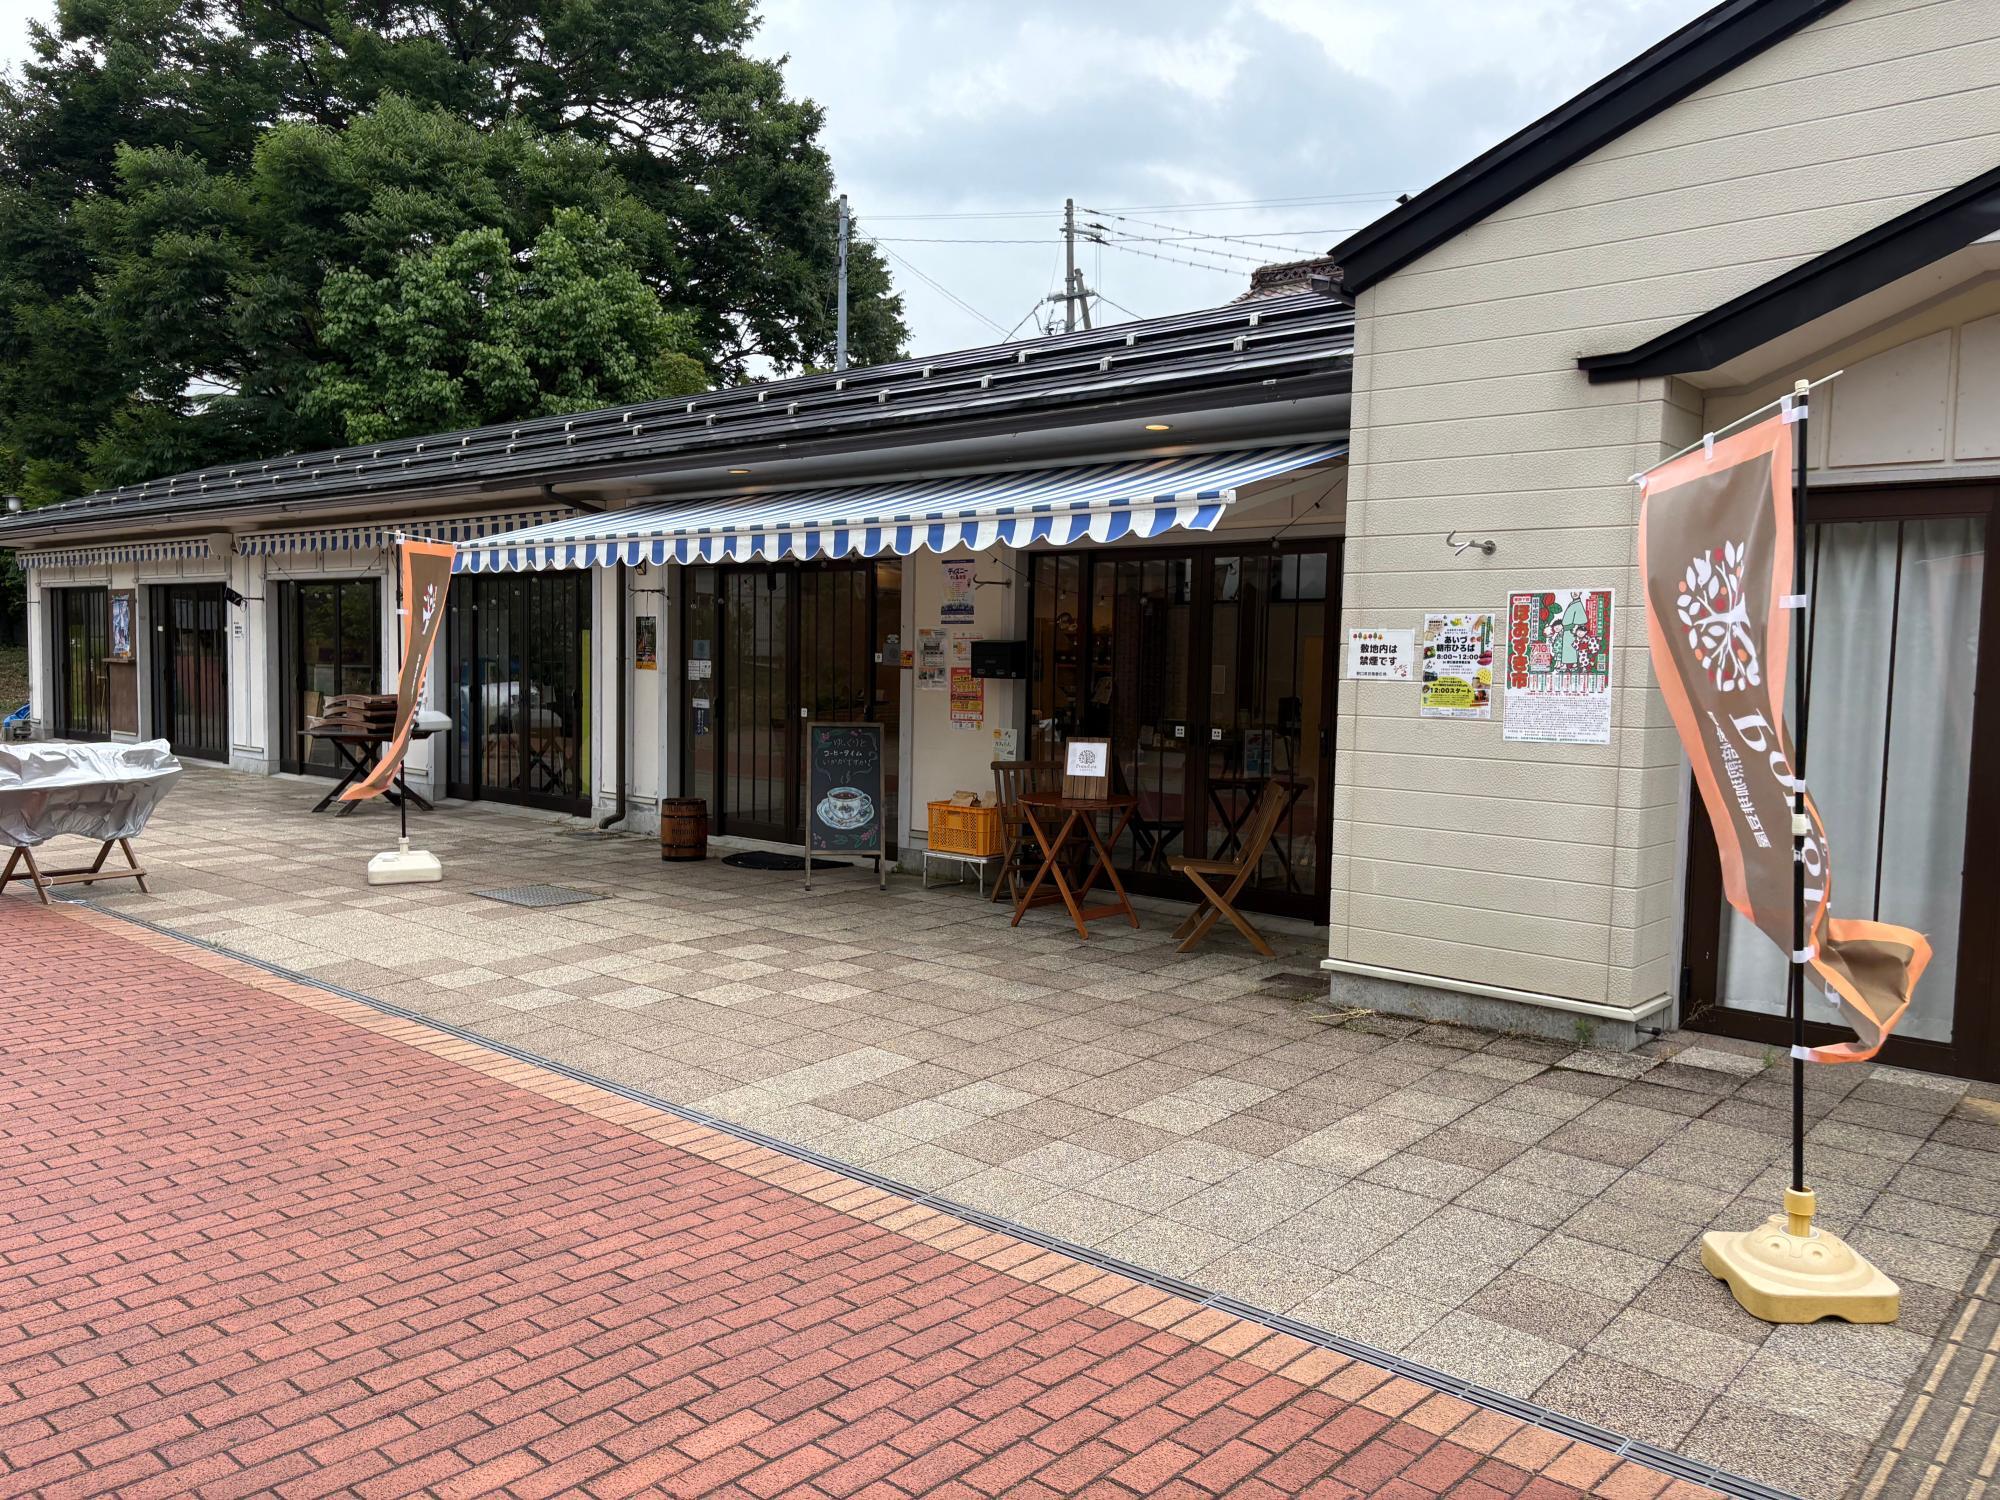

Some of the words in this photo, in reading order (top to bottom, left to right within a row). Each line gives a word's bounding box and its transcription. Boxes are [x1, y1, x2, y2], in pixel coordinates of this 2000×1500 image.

[1444, 635, 1468, 644] あいづ
[1360, 643, 1398, 654] 敷地内は
[1436, 644, 1476, 653] 朝市ひろば
[1511, 604, 1531, 688] ほおずき市
[1359, 655, 1398, 666] 禁煙です
[1430, 686, 1472, 694] 12:00スタート
[823, 749, 863, 757] コーヒータイム
